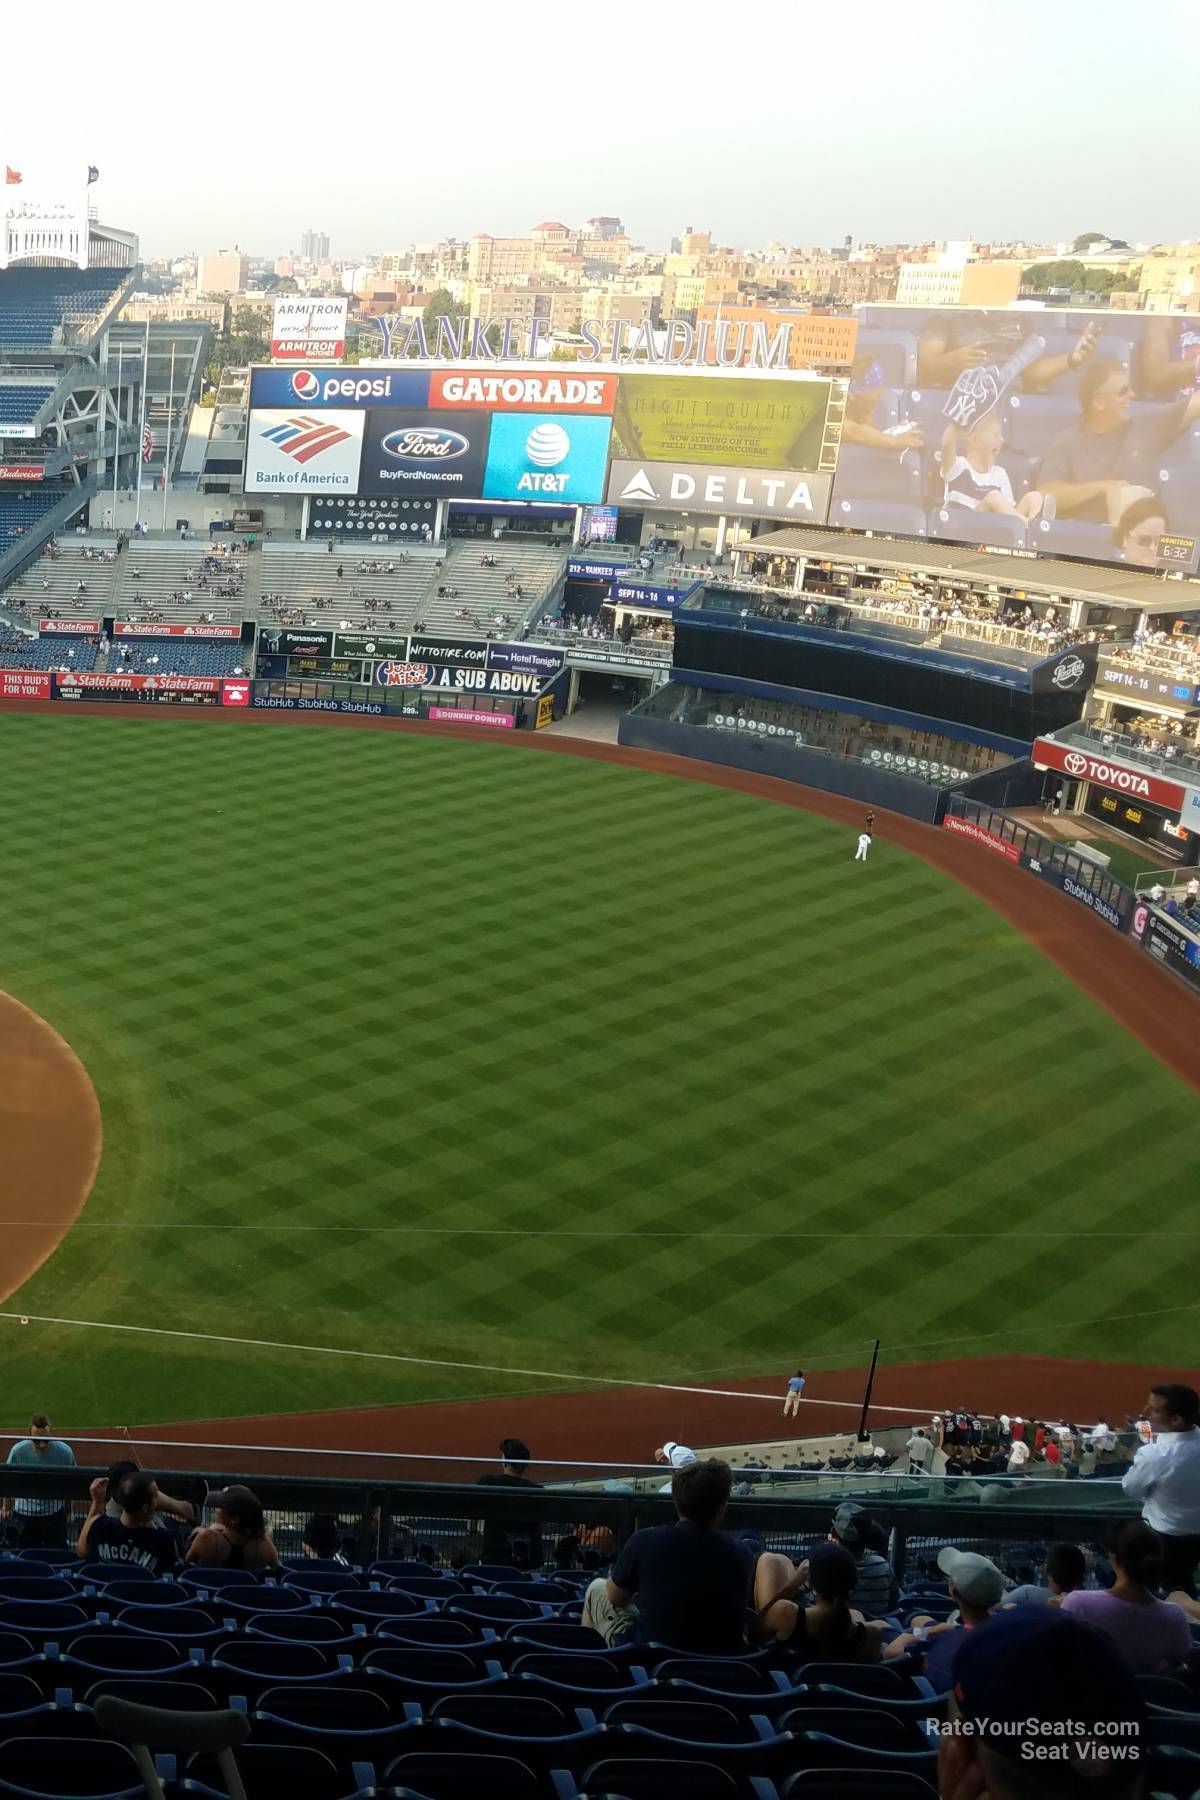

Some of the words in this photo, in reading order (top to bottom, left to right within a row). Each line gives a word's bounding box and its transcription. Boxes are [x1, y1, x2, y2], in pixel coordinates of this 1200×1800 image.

[278, 305, 342, 314] ARMITRON
[278, 342, 337, 351] ARMITRON
[376, 314, 552, 361] YANKEE
[577, 318, 794, 370] STADIUM
[324, 376, 391, 400] pepsi
[442, 377, 605, 404] GATORADE
[398, 430, 451, 456] Ford
[256, 471, 285, 484] Bank
[287, 471, 299, 485] of
[300, 472, 349, 485] America
[380, 470, 463, 481] BuyFordNow.com
[517, 473, 570, 491] AT&T
[670, 473, 814, 511] DELTA
[1163, 545, 1187, 559] 6:32
[569, 565, 581, 573] 212
[586, 566, 613, 576] YANKEES
[618, 589, 635, 598] SEPT
[287, 633, 327, 643] Panasonic
[385, 661, 427, 674] Jersey
[4, 675, 23, 684] THIS
[24, 675, 49, 685] BUD'S
[440, 669, 450, 686] A
[455, 669, 487, 688] SUB
[489, 672, 541, 692] ABOVE
[1104, 670, 1123, 683] SEPT
[1124, 675, 1133, 686] 14
[1140, 679, 1149, 690] 16
[3, 685, 20, 694] FOR
[21, 686, 41, 694] YOU.
[254, 697, 294, 707] StubHub
[298, 699, 337, 710] StubHub
[341, 701, 381, 713] StubHub
[475, 714, 506, 724] DONUTS
[1089, 761, 1150, 795] TOYOTA
[1163, 818, 1189, 841] FedEx
[1063, 878, 1094, 905] StubHub
[1093, 896, 1120, 927] StubHub
